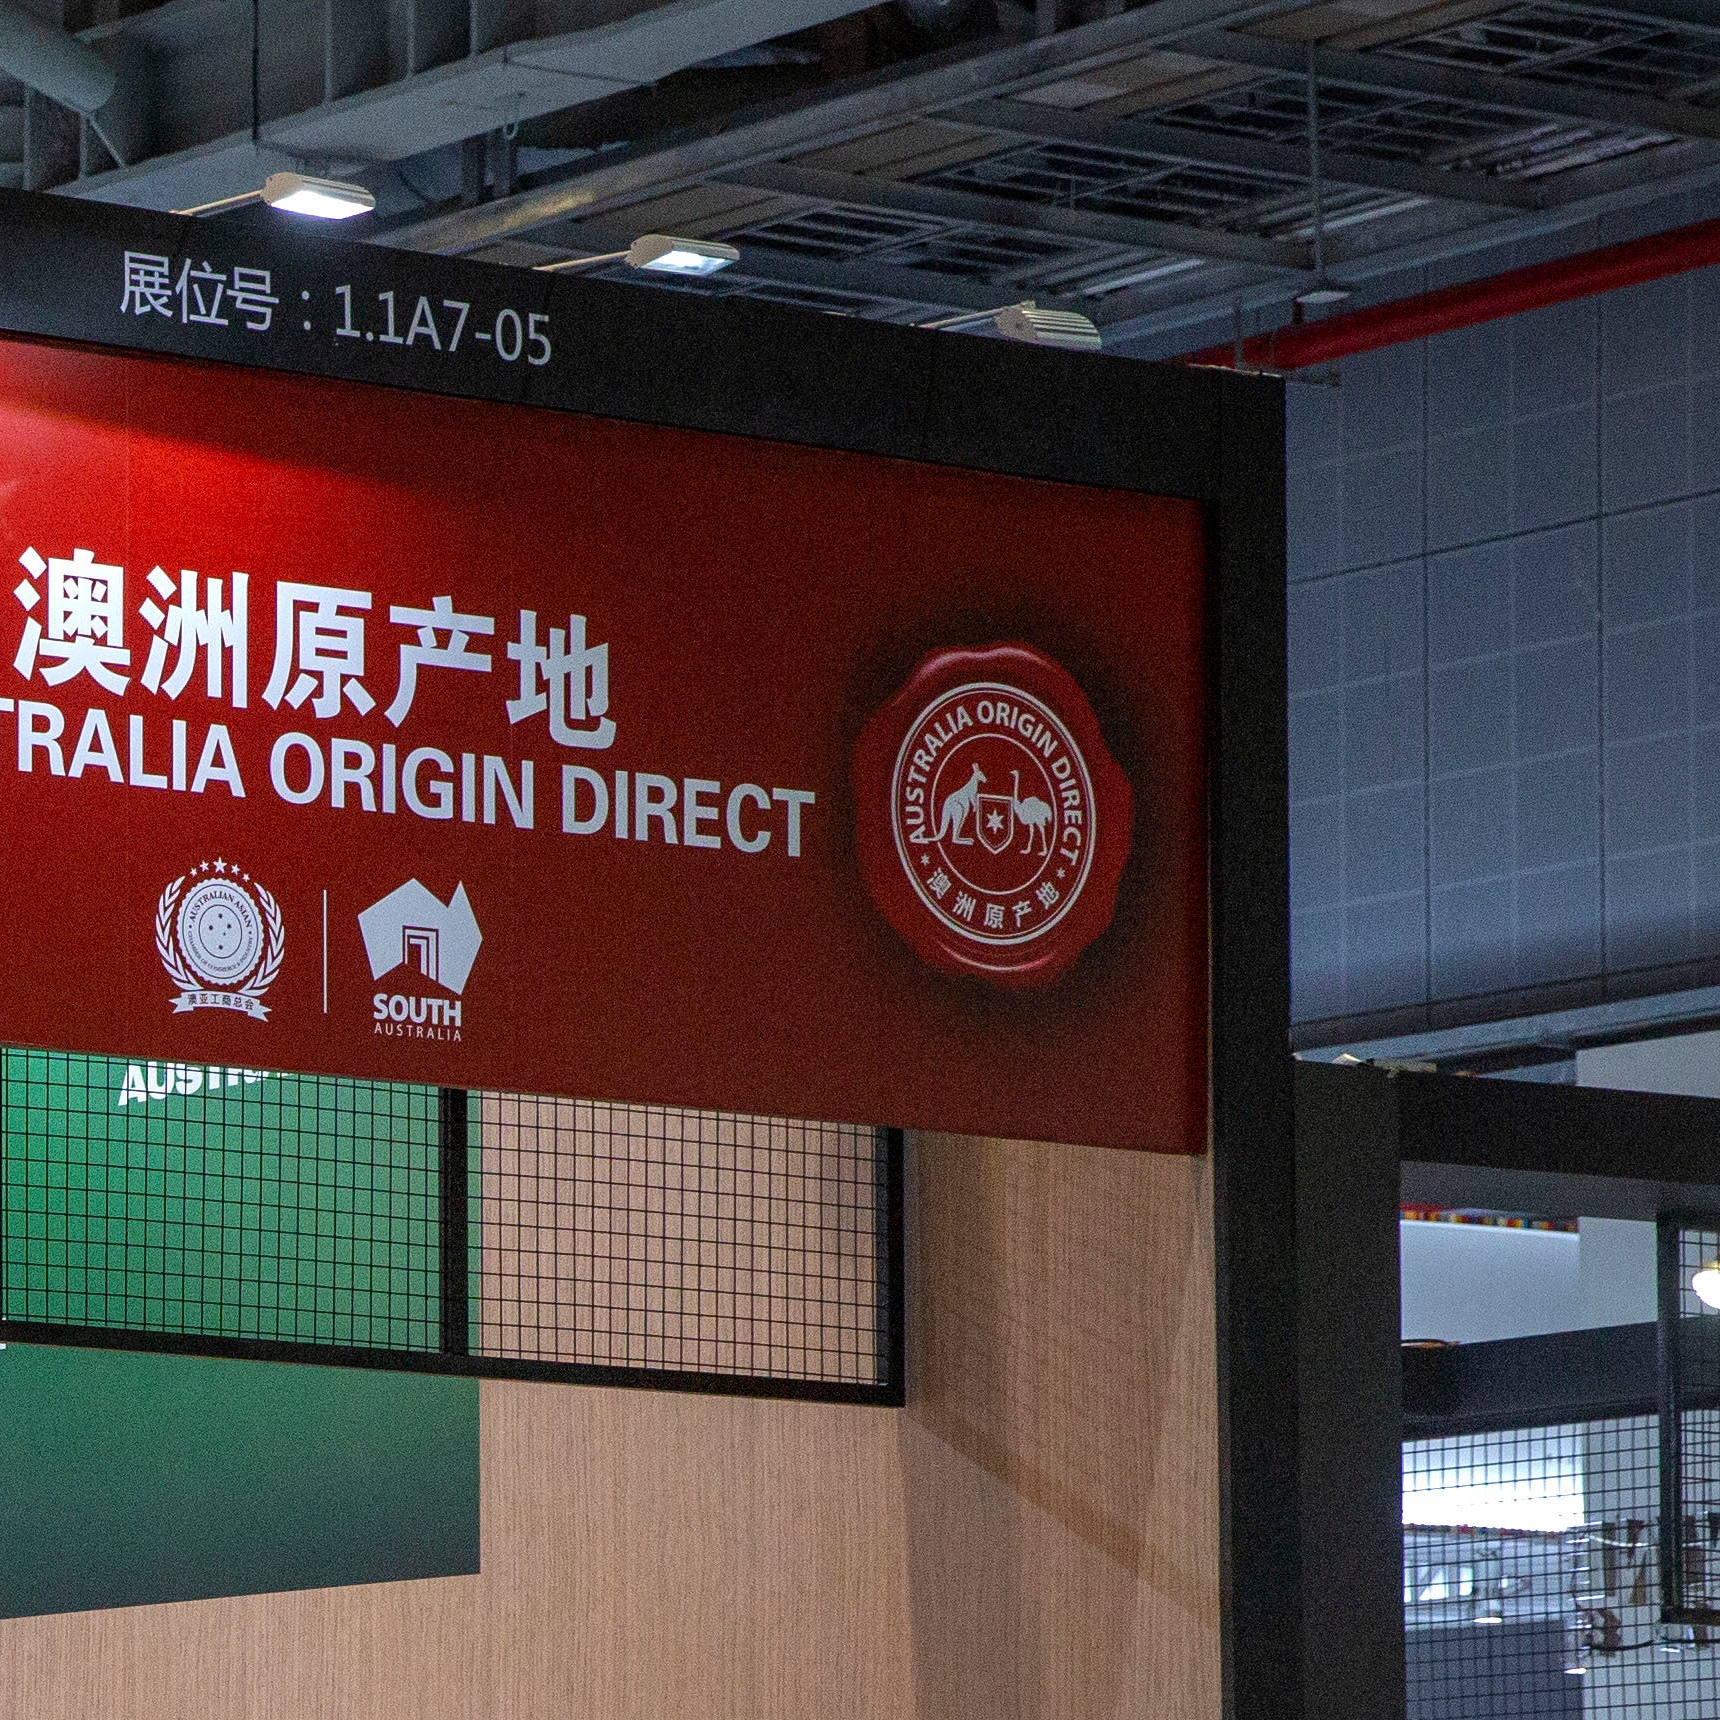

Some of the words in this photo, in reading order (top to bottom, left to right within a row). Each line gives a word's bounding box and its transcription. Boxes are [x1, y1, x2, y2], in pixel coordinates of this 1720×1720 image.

[333, 282, 554, 367] 1.1A7-05
[13, 544, 618, 752] 澳洲原产地
[268, 730, 536, 831] ORIGIN
[559, 761, 816, 859] DIRECT
[904, 705, 974, 845] AUSTRALIA
[976, 699, 1059, 758] ORIGIN
[1050, 755, 1083, 866] DIRECT
[372, 992, 462, 1028] SOUTH
[373, 1021, 463, 1042] AUSTRALIA
